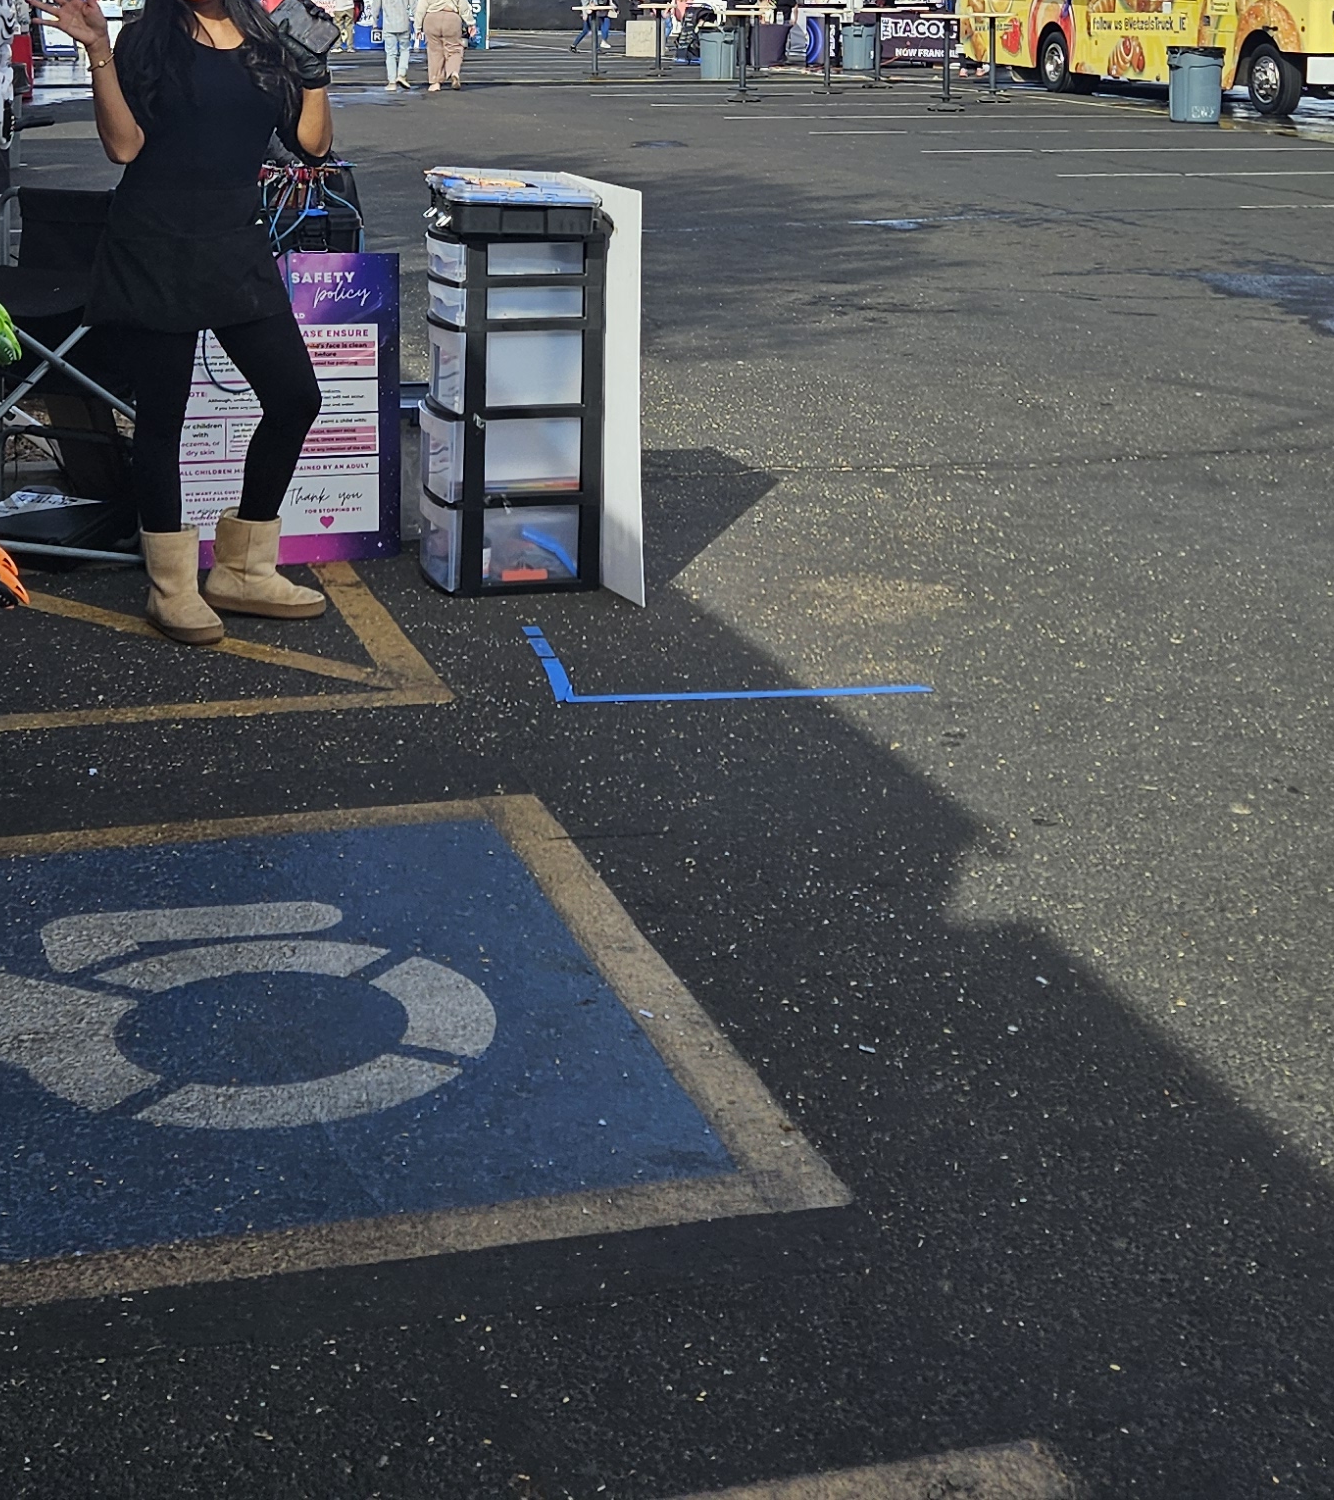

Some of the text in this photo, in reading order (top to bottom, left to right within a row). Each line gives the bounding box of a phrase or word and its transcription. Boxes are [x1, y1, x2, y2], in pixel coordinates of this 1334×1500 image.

[895, 48, 917, 58] NOW
[291, 271, 355, 284] SAFETY
[313, 280, 371, 309] policy
[327, 329, 369, 337] ENSURE
[289, 487, 363, 506] Thank you
